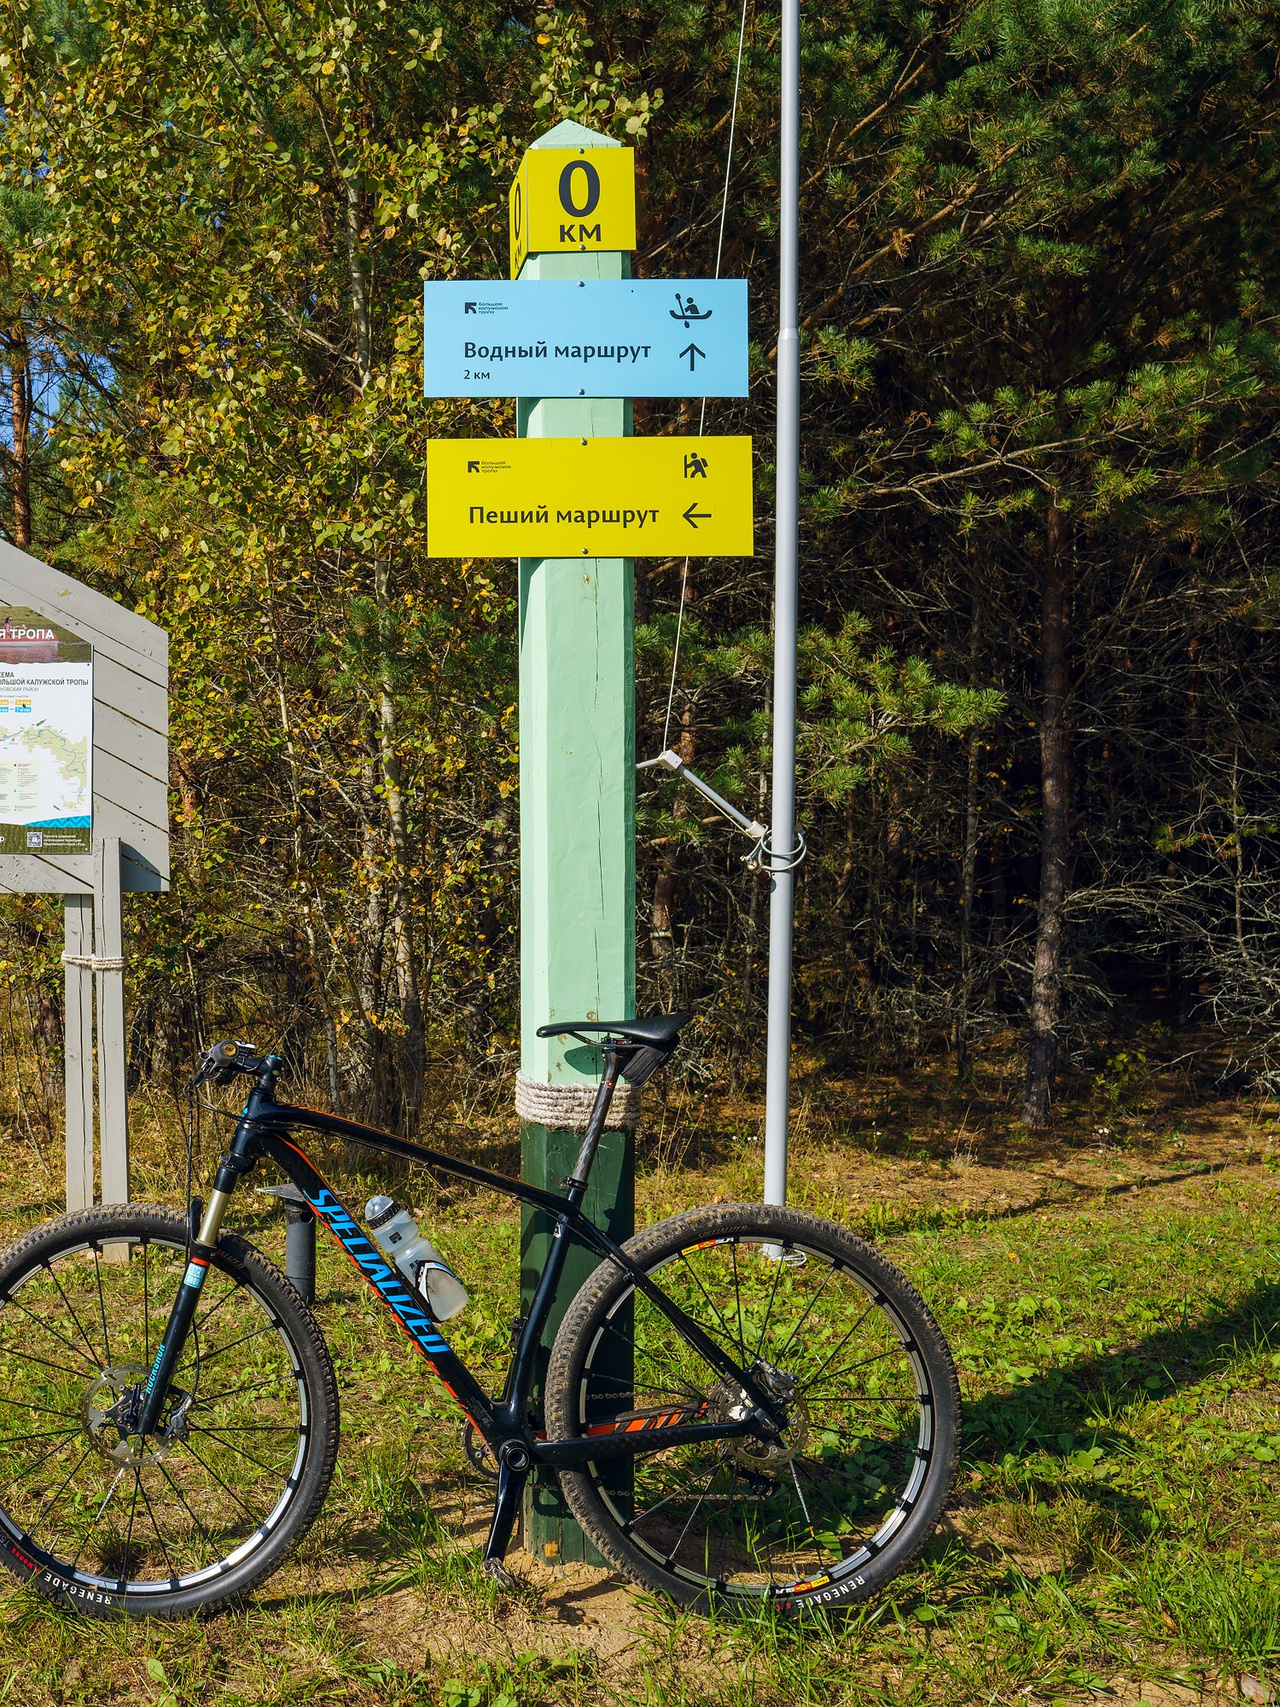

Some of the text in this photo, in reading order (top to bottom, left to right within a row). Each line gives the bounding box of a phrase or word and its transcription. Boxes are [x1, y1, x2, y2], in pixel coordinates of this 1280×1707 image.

[558, 160, 601, 218] 0
[464, 340, 652, 363] Водный маршрут
[464, 369, 490, 380] 2 км
[469, 504, 660, 529] Пеший маршрут
[10, 628, 55, 640] ТРОПА
[303, 1189, 452, 1353] SPECIALIZED
[44, 1572, 112, 1605] RENEGADE
